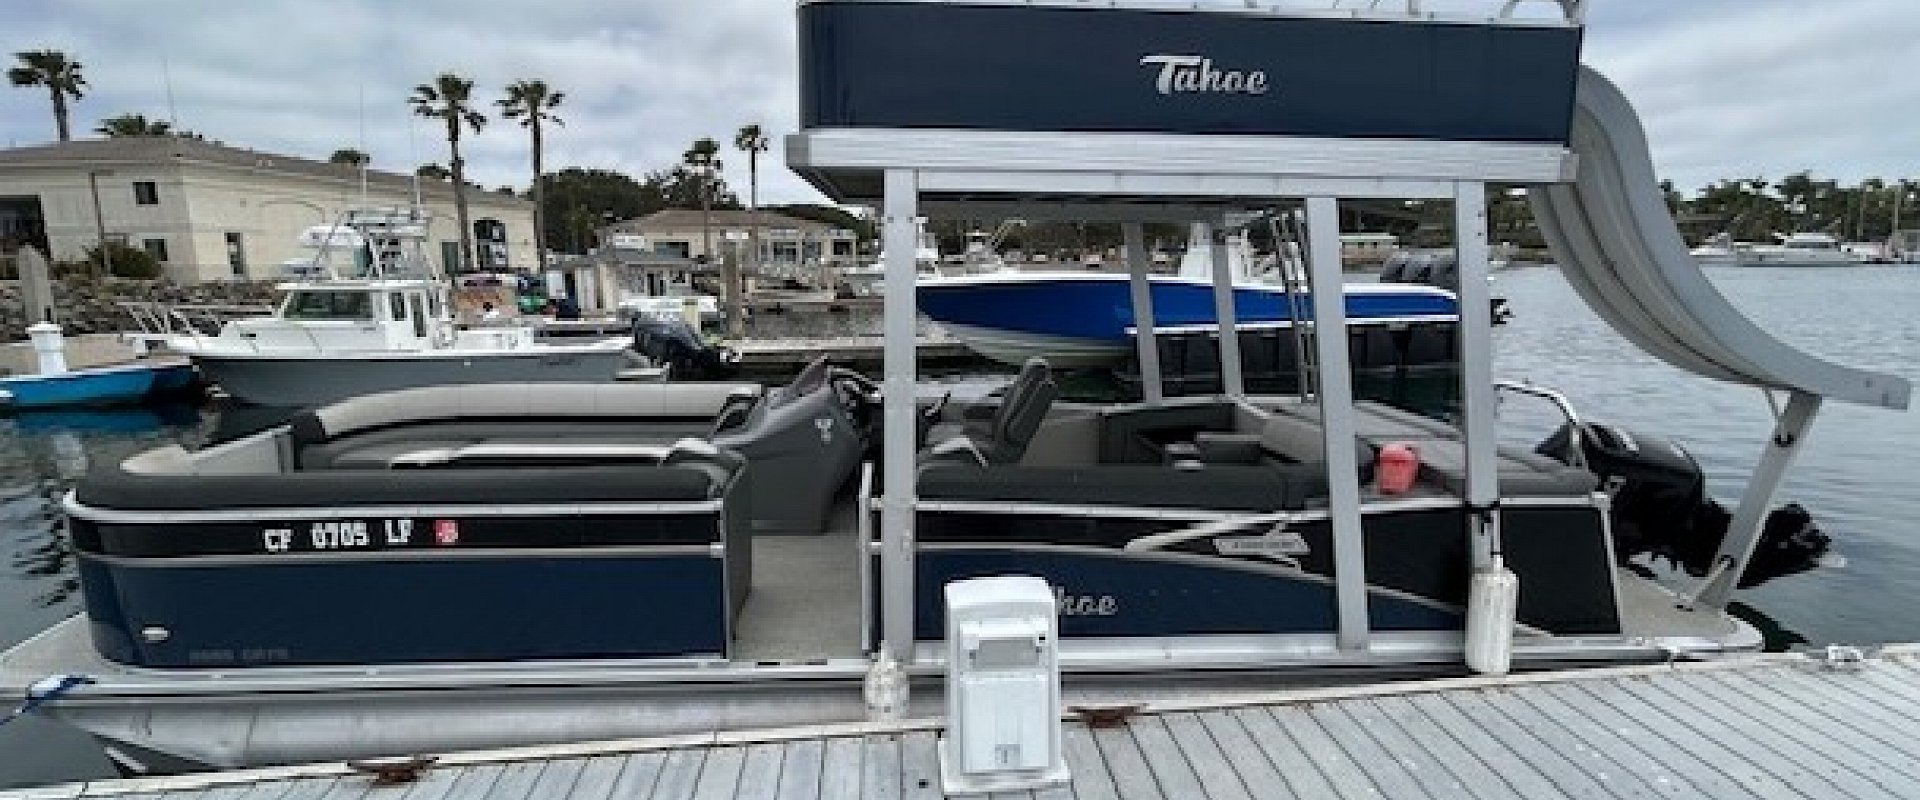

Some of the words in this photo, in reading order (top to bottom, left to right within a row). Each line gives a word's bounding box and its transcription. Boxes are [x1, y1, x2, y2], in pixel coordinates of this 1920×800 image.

[1139, 55, 1269, 95] Tahoe
[263, 528, 292, 551] CF
[1055, 586, 1118, 615] hoe
